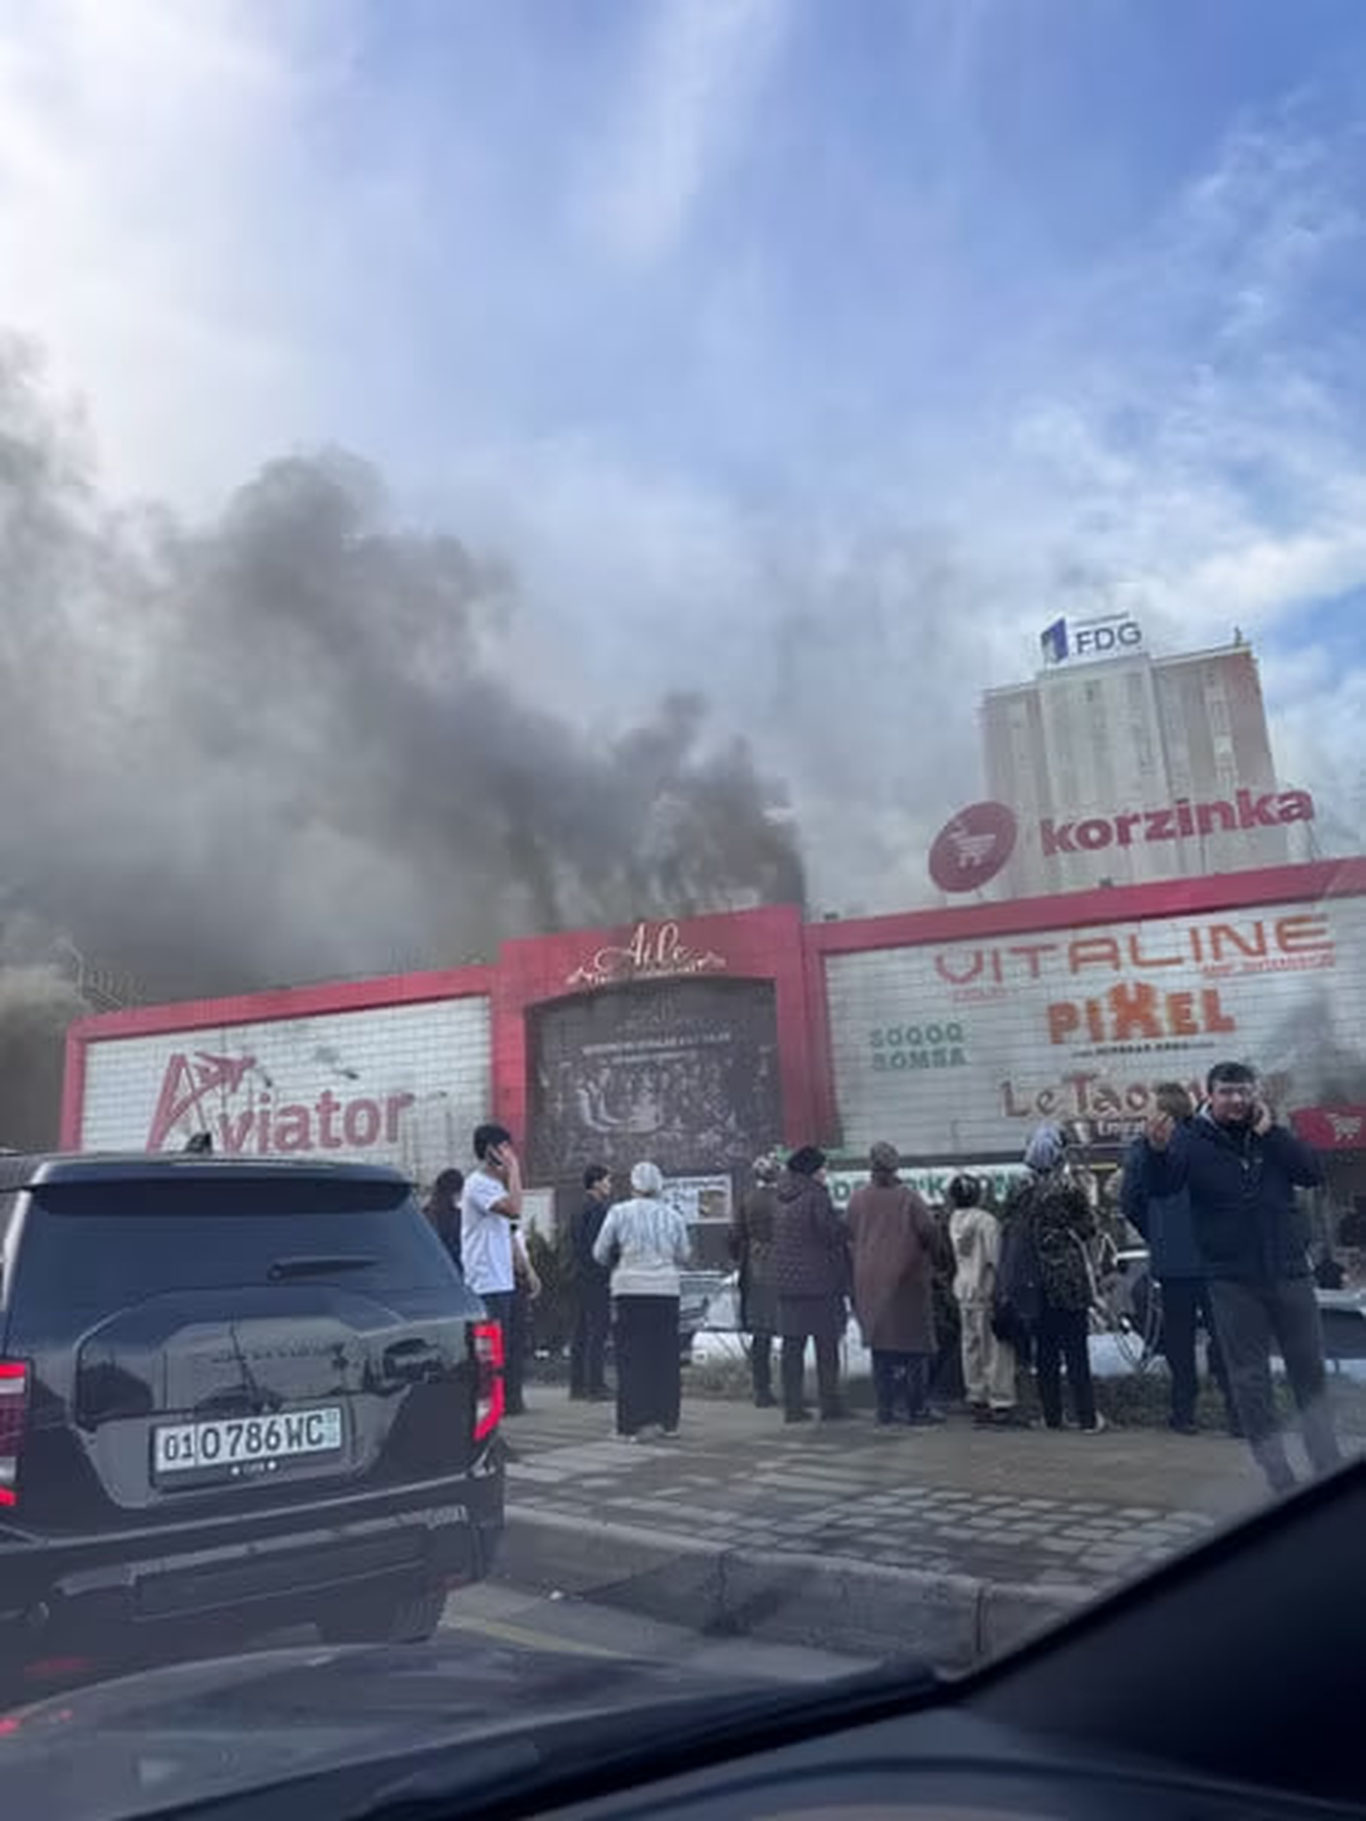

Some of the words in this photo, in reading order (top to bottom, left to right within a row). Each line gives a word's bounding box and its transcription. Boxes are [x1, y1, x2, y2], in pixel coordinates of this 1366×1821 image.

[1076, 621, 1142, 655] FDG
[1040, 788, 1315, 856] korzinka
[935, 914, 1335, 985] VITALINE
[1047, 981, 1236, 1045] PIXEL
[1002, 1079, 1058, 1117] Le
